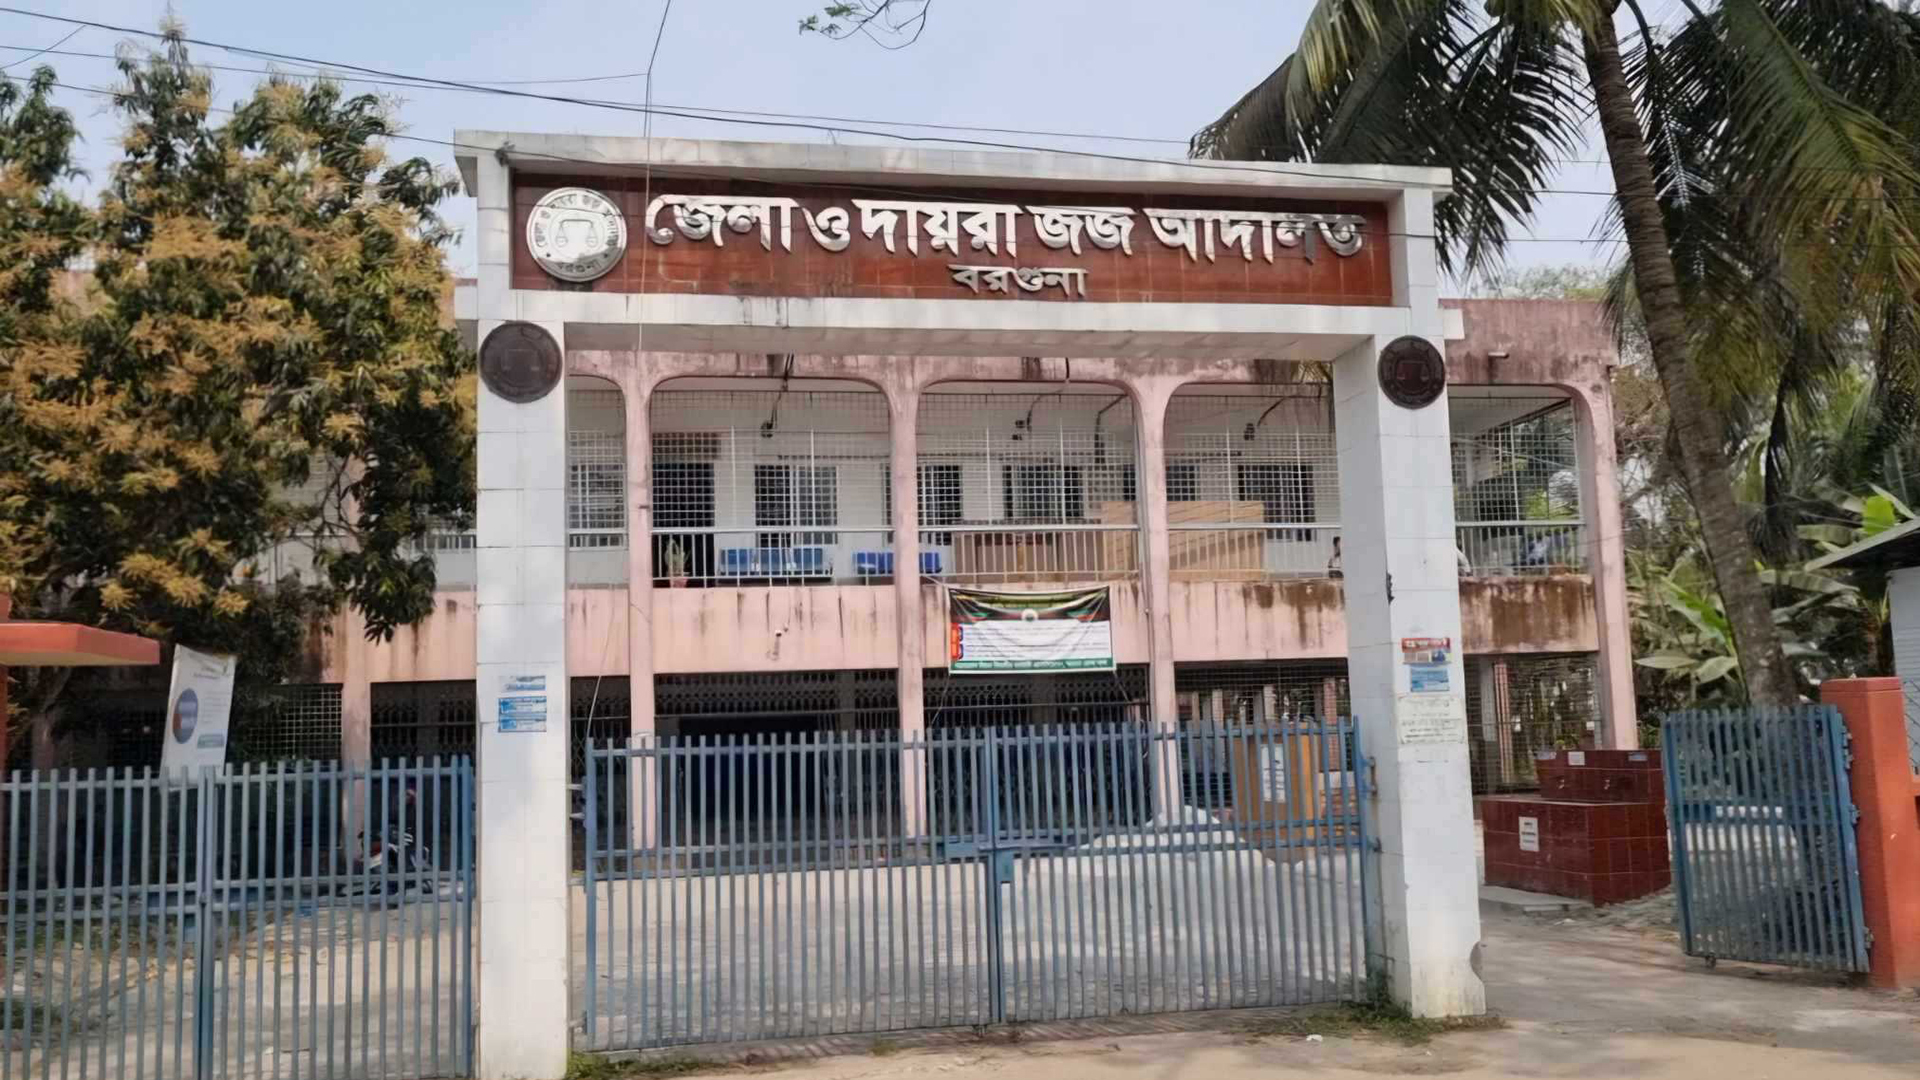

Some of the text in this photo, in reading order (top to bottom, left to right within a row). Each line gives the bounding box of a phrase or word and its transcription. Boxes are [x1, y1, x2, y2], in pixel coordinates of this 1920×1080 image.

[648, 195, 1366, 263] জেলা ও দায়রা জজ আদালত
[949, 265, 1088, 296] বরগুনা
